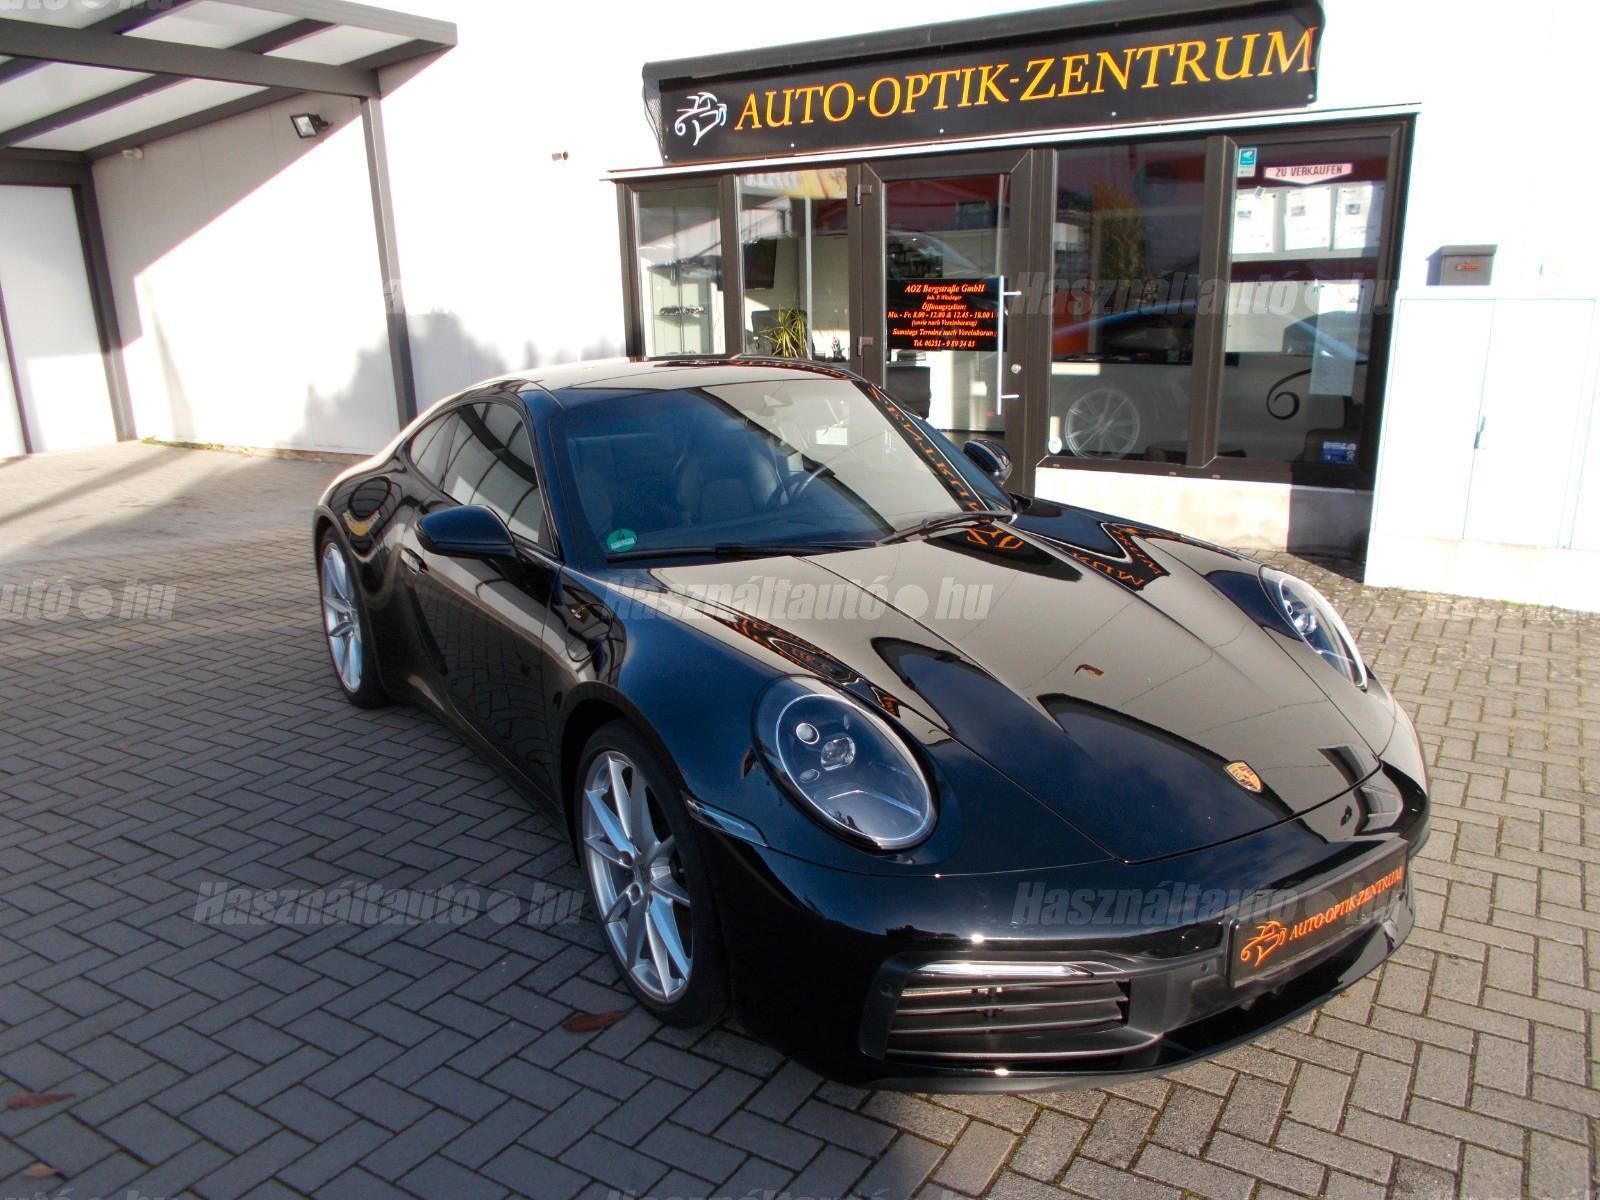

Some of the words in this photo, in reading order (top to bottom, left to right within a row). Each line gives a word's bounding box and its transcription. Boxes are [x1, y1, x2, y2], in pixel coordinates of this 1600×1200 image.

[734, 26, 1319, 131] AUTO-OPTIK-ZENTRUM
[1275, 167, 1287, 177] ZU
[1290, 165, 1343, 177] VERKAUFEN
[904, 284, 921, 293] AOZ
[922, 284, 960, 294] Bergstraße
[961, 284, 986, 293] GmbH
[1289, 865, 1404, 941] AUTO-OPTIK-ZENTRUM
